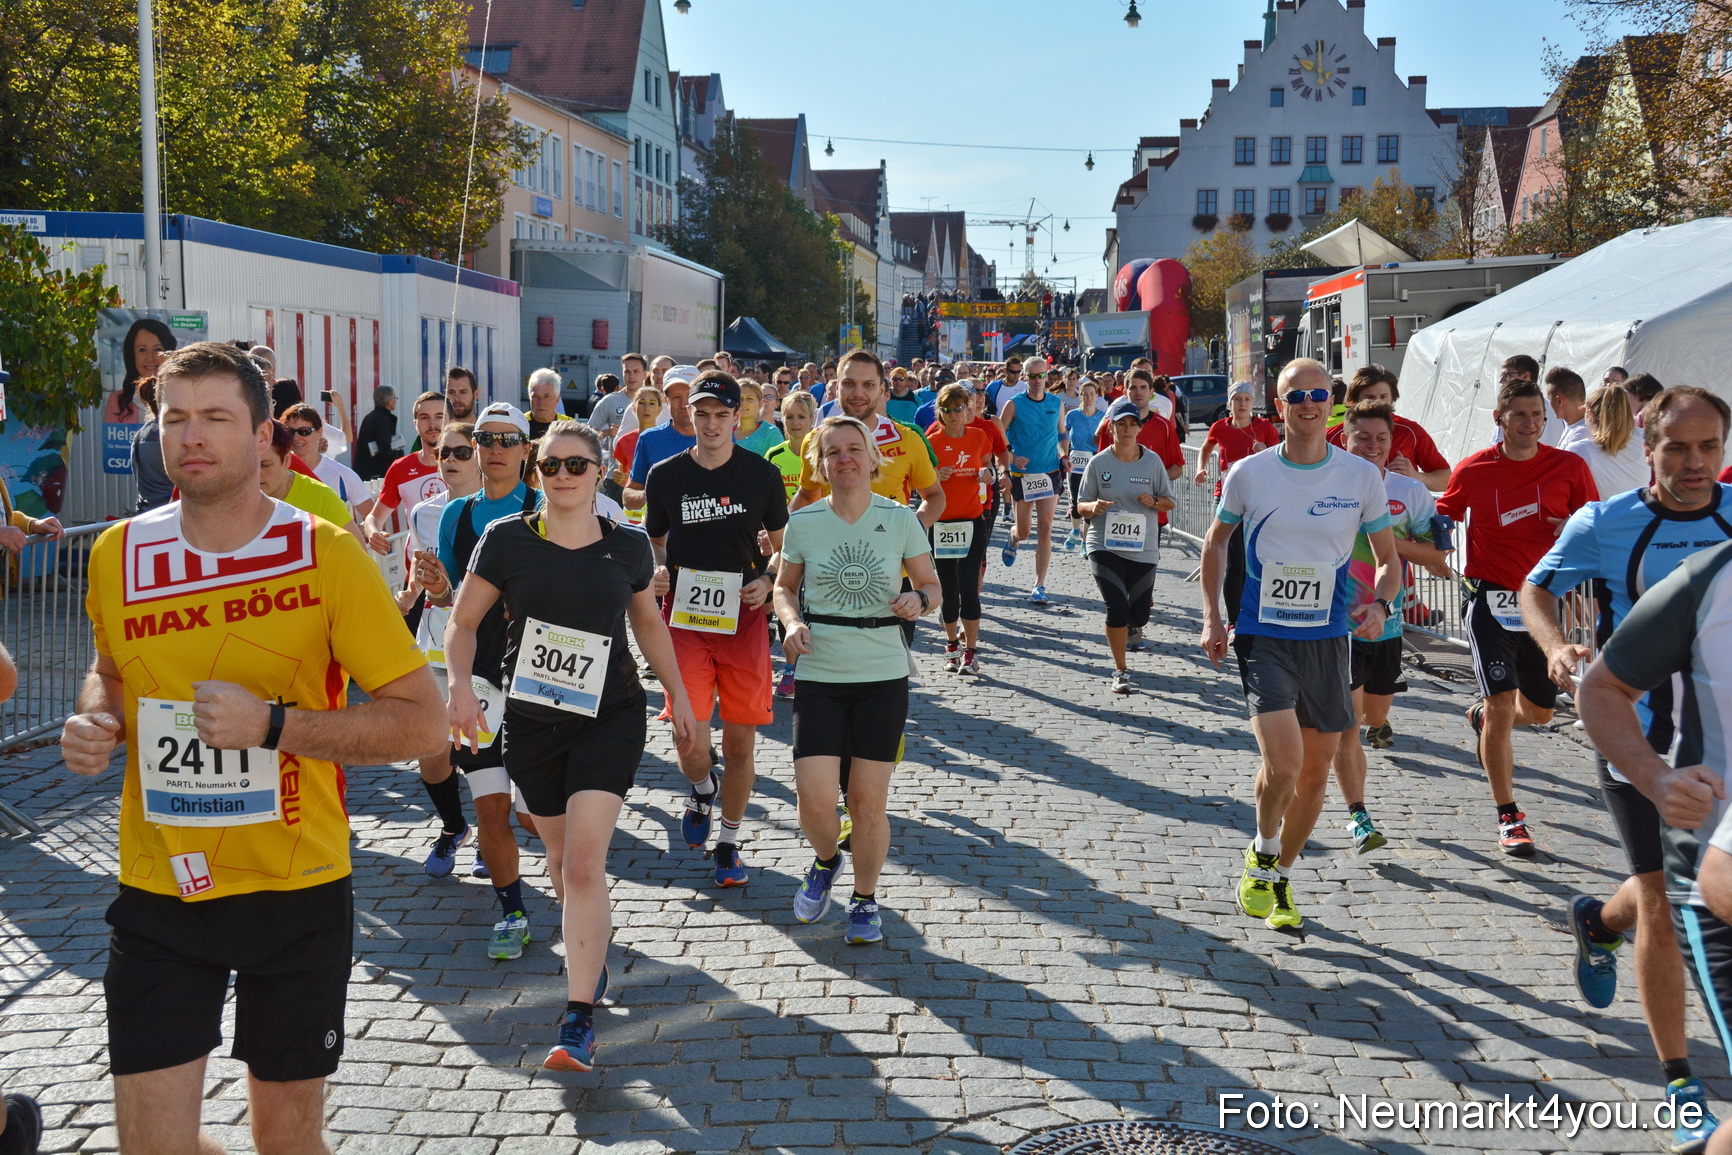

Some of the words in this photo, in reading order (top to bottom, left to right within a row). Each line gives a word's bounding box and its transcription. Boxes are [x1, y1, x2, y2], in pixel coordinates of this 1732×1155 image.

[972, 305, 1006, 314] START
[108, 426, 135, 444] Helg
[108, 458, 131, 468] CSU
[1072, 457, 1089, 466] 2079
[1026, 479, 1048, 490] 2356
[681, 498, 720, 511] SWIM.
[682, 504, 746, 520] BIKE.RUN.
[1511, 508, 1528, 518] DEHN
[1111, 522, 1140, 536] 2014
[940, 532, 966, 543] 2511
[1282, 566, 1315, 576] BOCK
[695, 574, 724, 584] BOCK
[1271, 578, 1320, 600] 2071
[689, 586, 725, 608] 210
[1496, 592, 1518, 608] 24
[124, 604, 212, 642] MAX
[224, 584, 321, 623] BÖGL
[1276, 610, 1314, 620] Christian
[688, 616, 720, 626] Michael
[548, 632, 586, 648] BOCK
[532, 644, 594, 680] 3047
[534, 672, 551, 681] PARTL
[552, 676, 576, 688] Neumarkt
[158, 736, 249, 775] 2411
[166, 780, 194, 788] PARTL
[196, 780, 236, 788] Neumarkt
[171, 796, 245, 813] Christian
